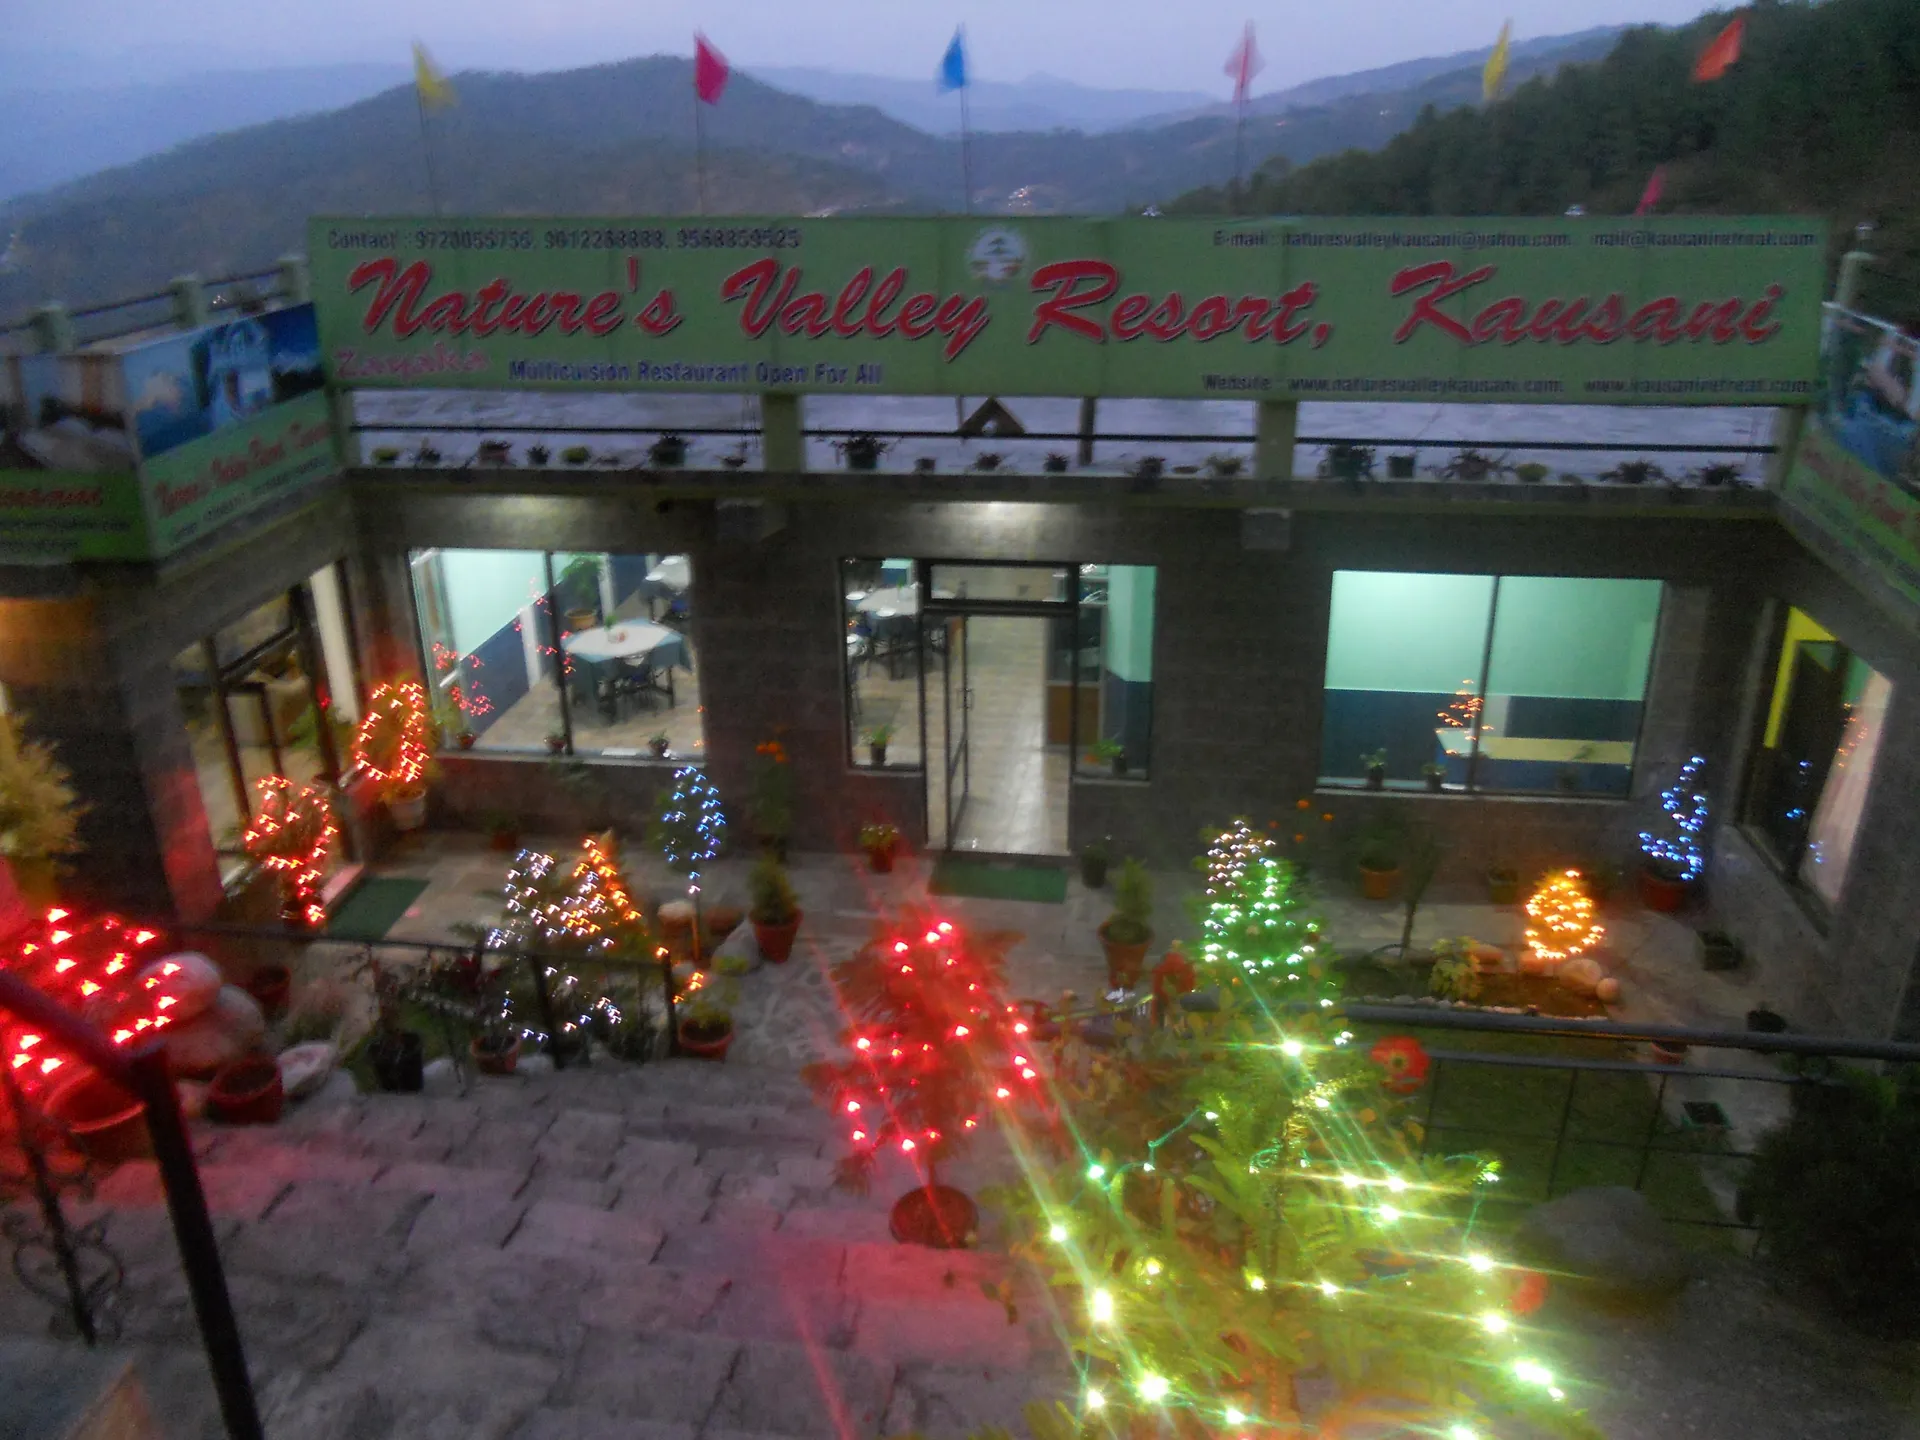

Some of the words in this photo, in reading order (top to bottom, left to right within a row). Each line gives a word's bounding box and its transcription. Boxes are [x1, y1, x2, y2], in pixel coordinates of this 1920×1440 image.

[328, 228, 399, 250] Contact
[348, 256, 683, 340] Nature's
[720, 257, 990, 364] Valley
[1027, 260, 1332, 349] Resort,
[1390, 260, 1786, 345] Kausani
[637, 360, 749, 382] Restaurant
[755, 361, 810, 387] Open
[814, 361, 849, 384] For
[854, 362, 883, 384] All
